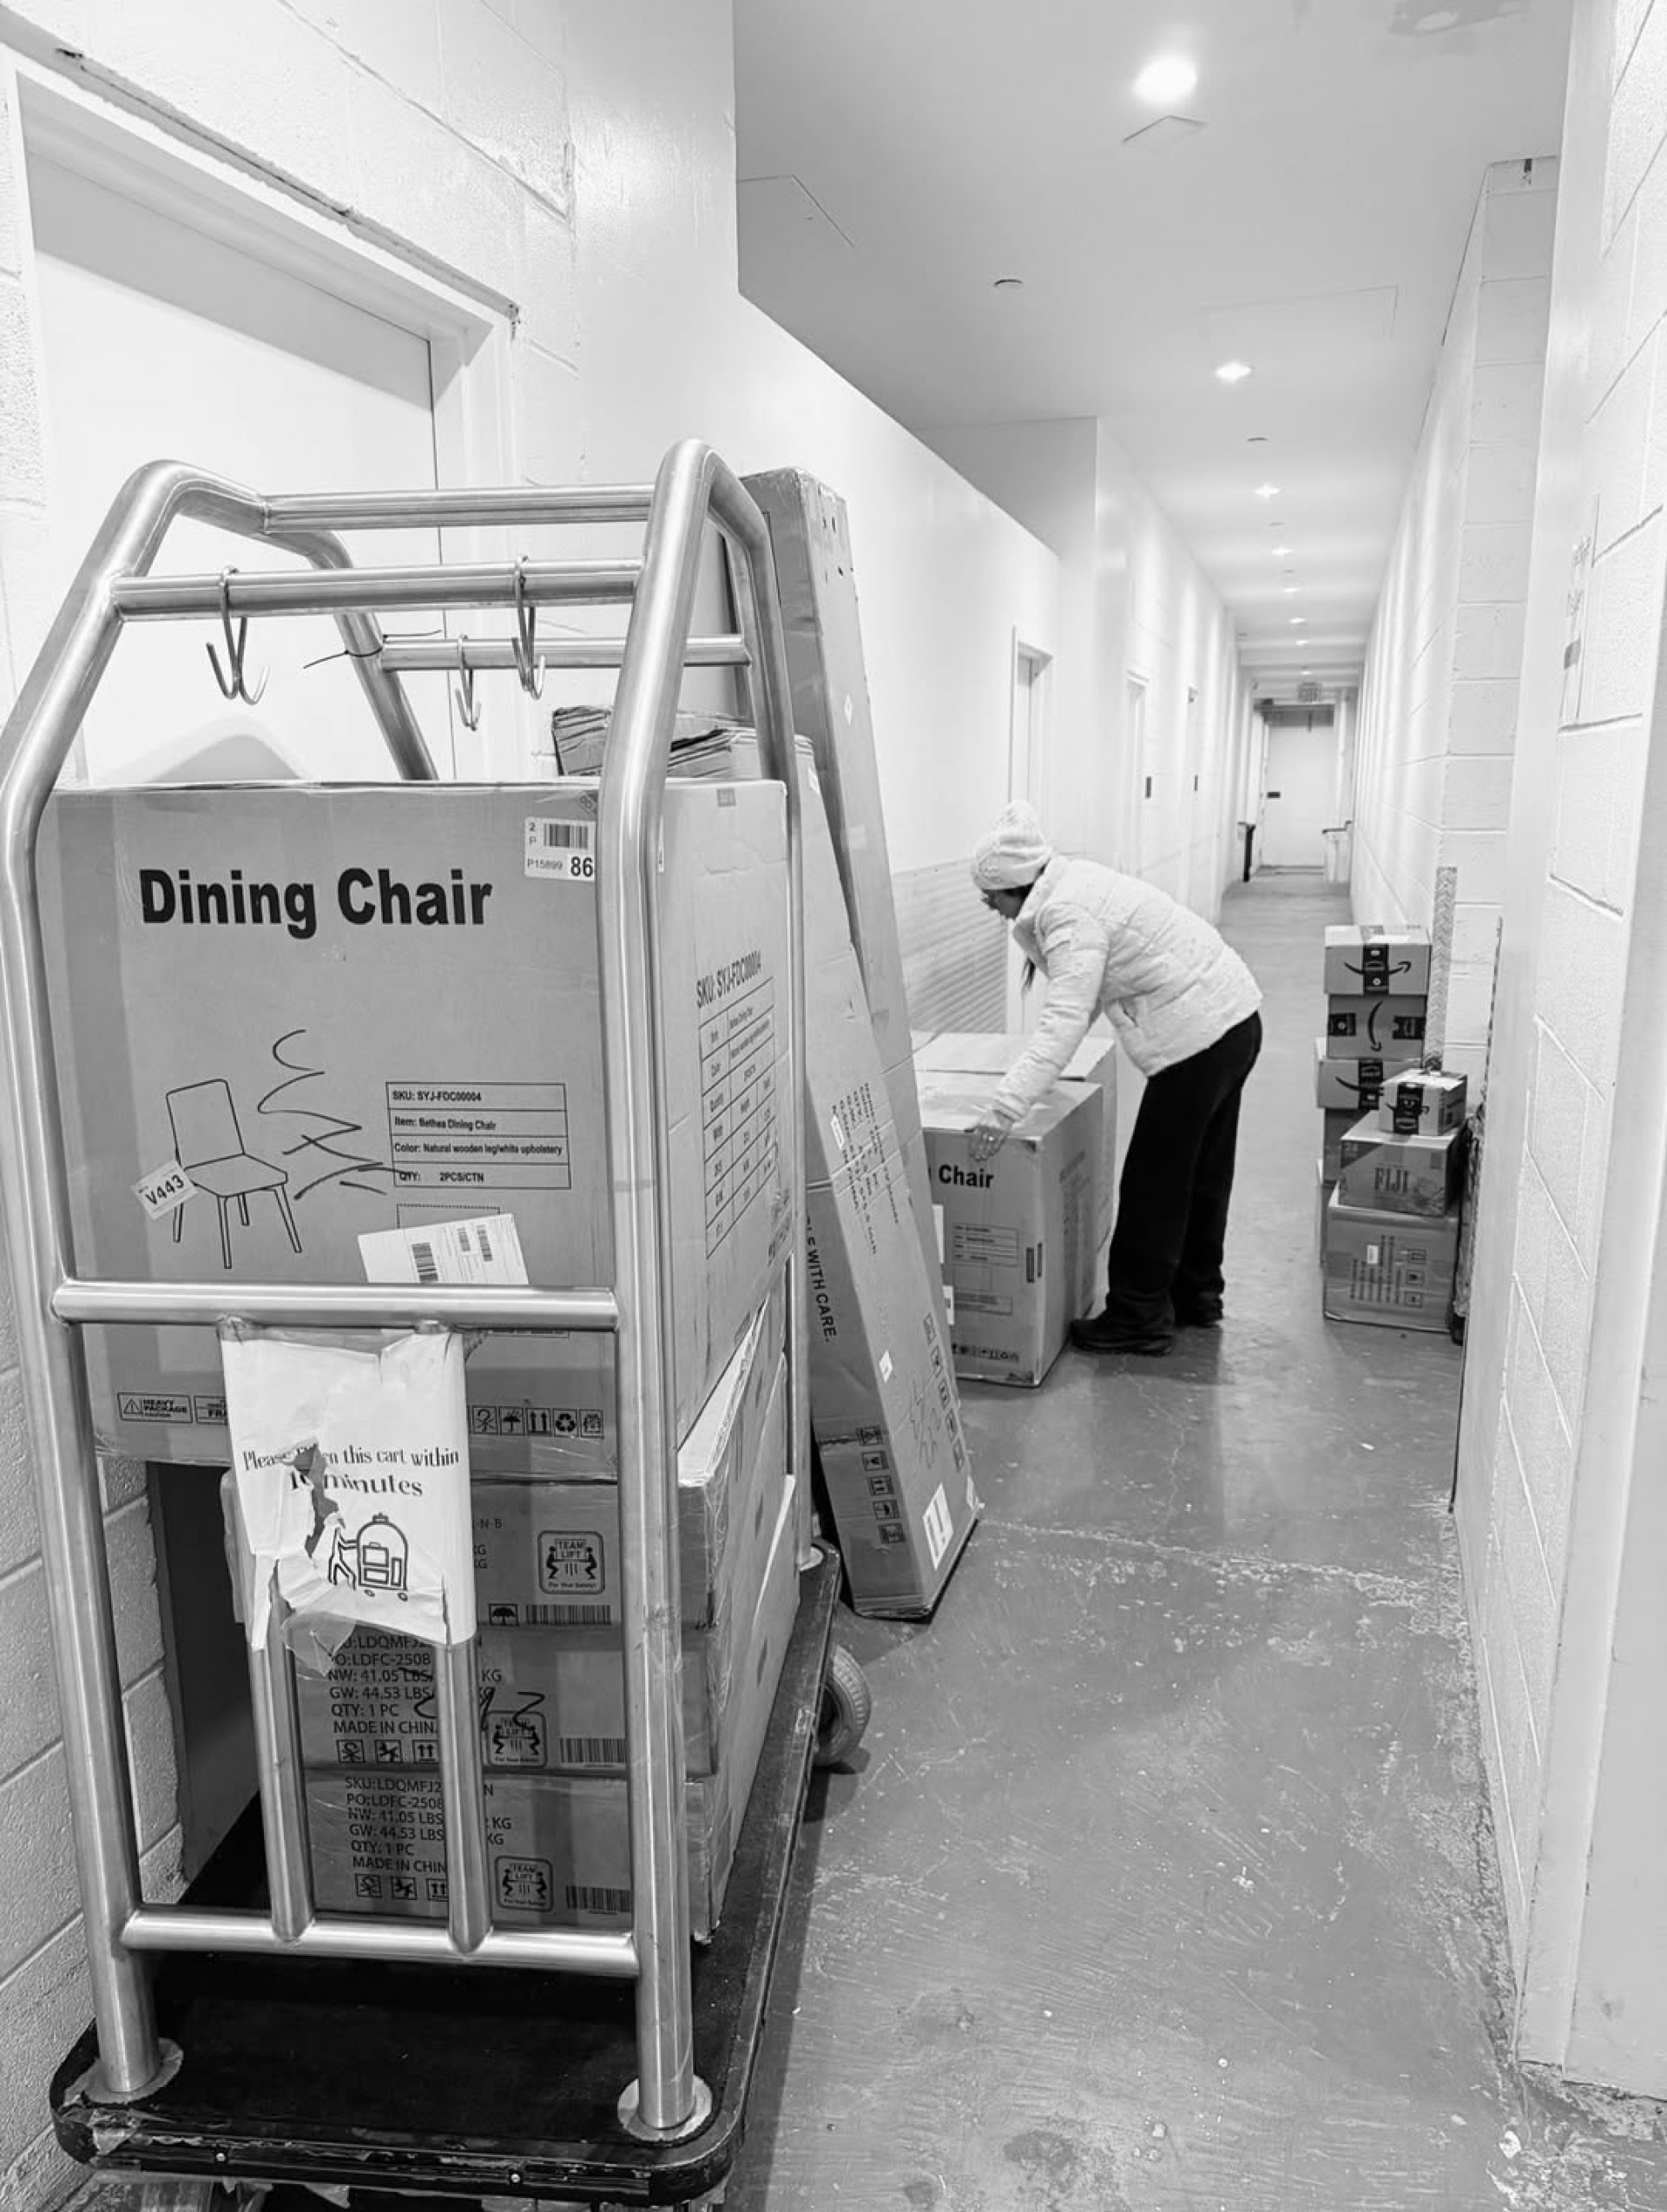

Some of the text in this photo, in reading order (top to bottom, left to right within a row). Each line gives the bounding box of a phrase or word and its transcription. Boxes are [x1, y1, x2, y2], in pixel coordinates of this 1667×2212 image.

[570, 855, 594, 877] 86
[139, 868, 493, 940] Dining Chair
[392, 1091, 415, 1101] SKU:
[394, 1116, 418, 1127] Item:
[447, 1119, 473, 1131] Dining
[475, 1120, 497, 1130] Chair
[394, 1142, 421, 1152] Color:
[423, 1143, 451, 1153] Natural
[452, 1144, 484, 1153] wooden
[521, 1144, 563, 1156] upholstery
[938, 1164, 994, 1189] Chair
[1374, 1167, 1409, 1194] FIJI
[144, 1174, 184, 1205] V443
[807, 1249, 827, 1291] WITH
[815, 1293, 837, 1344] CARE.
[344, 1445, 372, 1464] this
[377, 1448, 407, 1464] cart
[411, 1446, 459, 1468] within
[324, 1473, 424, 1497] minutes
[333, 1652, 432, 1667] O:LDFC-2508
[328, 1669, 358, 1681] NW:
[361, 1669, 399, 1682] 41.05
[481, 1668, 503, 1682] KG
[330, 1687, 359, 1700] GW:
[362, 1687, 401, 1700] 44.53
[332, 1704, 399, 1717] QTY: 1 PC
[333, 1720, 439, 1734] MADE IN CHIN
[348, 1806, 376, 1821] NW:
[380, 1810, 415, 1823] 41.05
[491, 1816, 512, 1830] KG
[349, 1824, 378, 1837] GW:
[380, 1826, 416, 1839] 44.53
[351, 1840, 382, 1854] QTY:
[396, 1842, 415, 1856] PC
[353, 1856, 446, 1873] MADE IN CHIN
